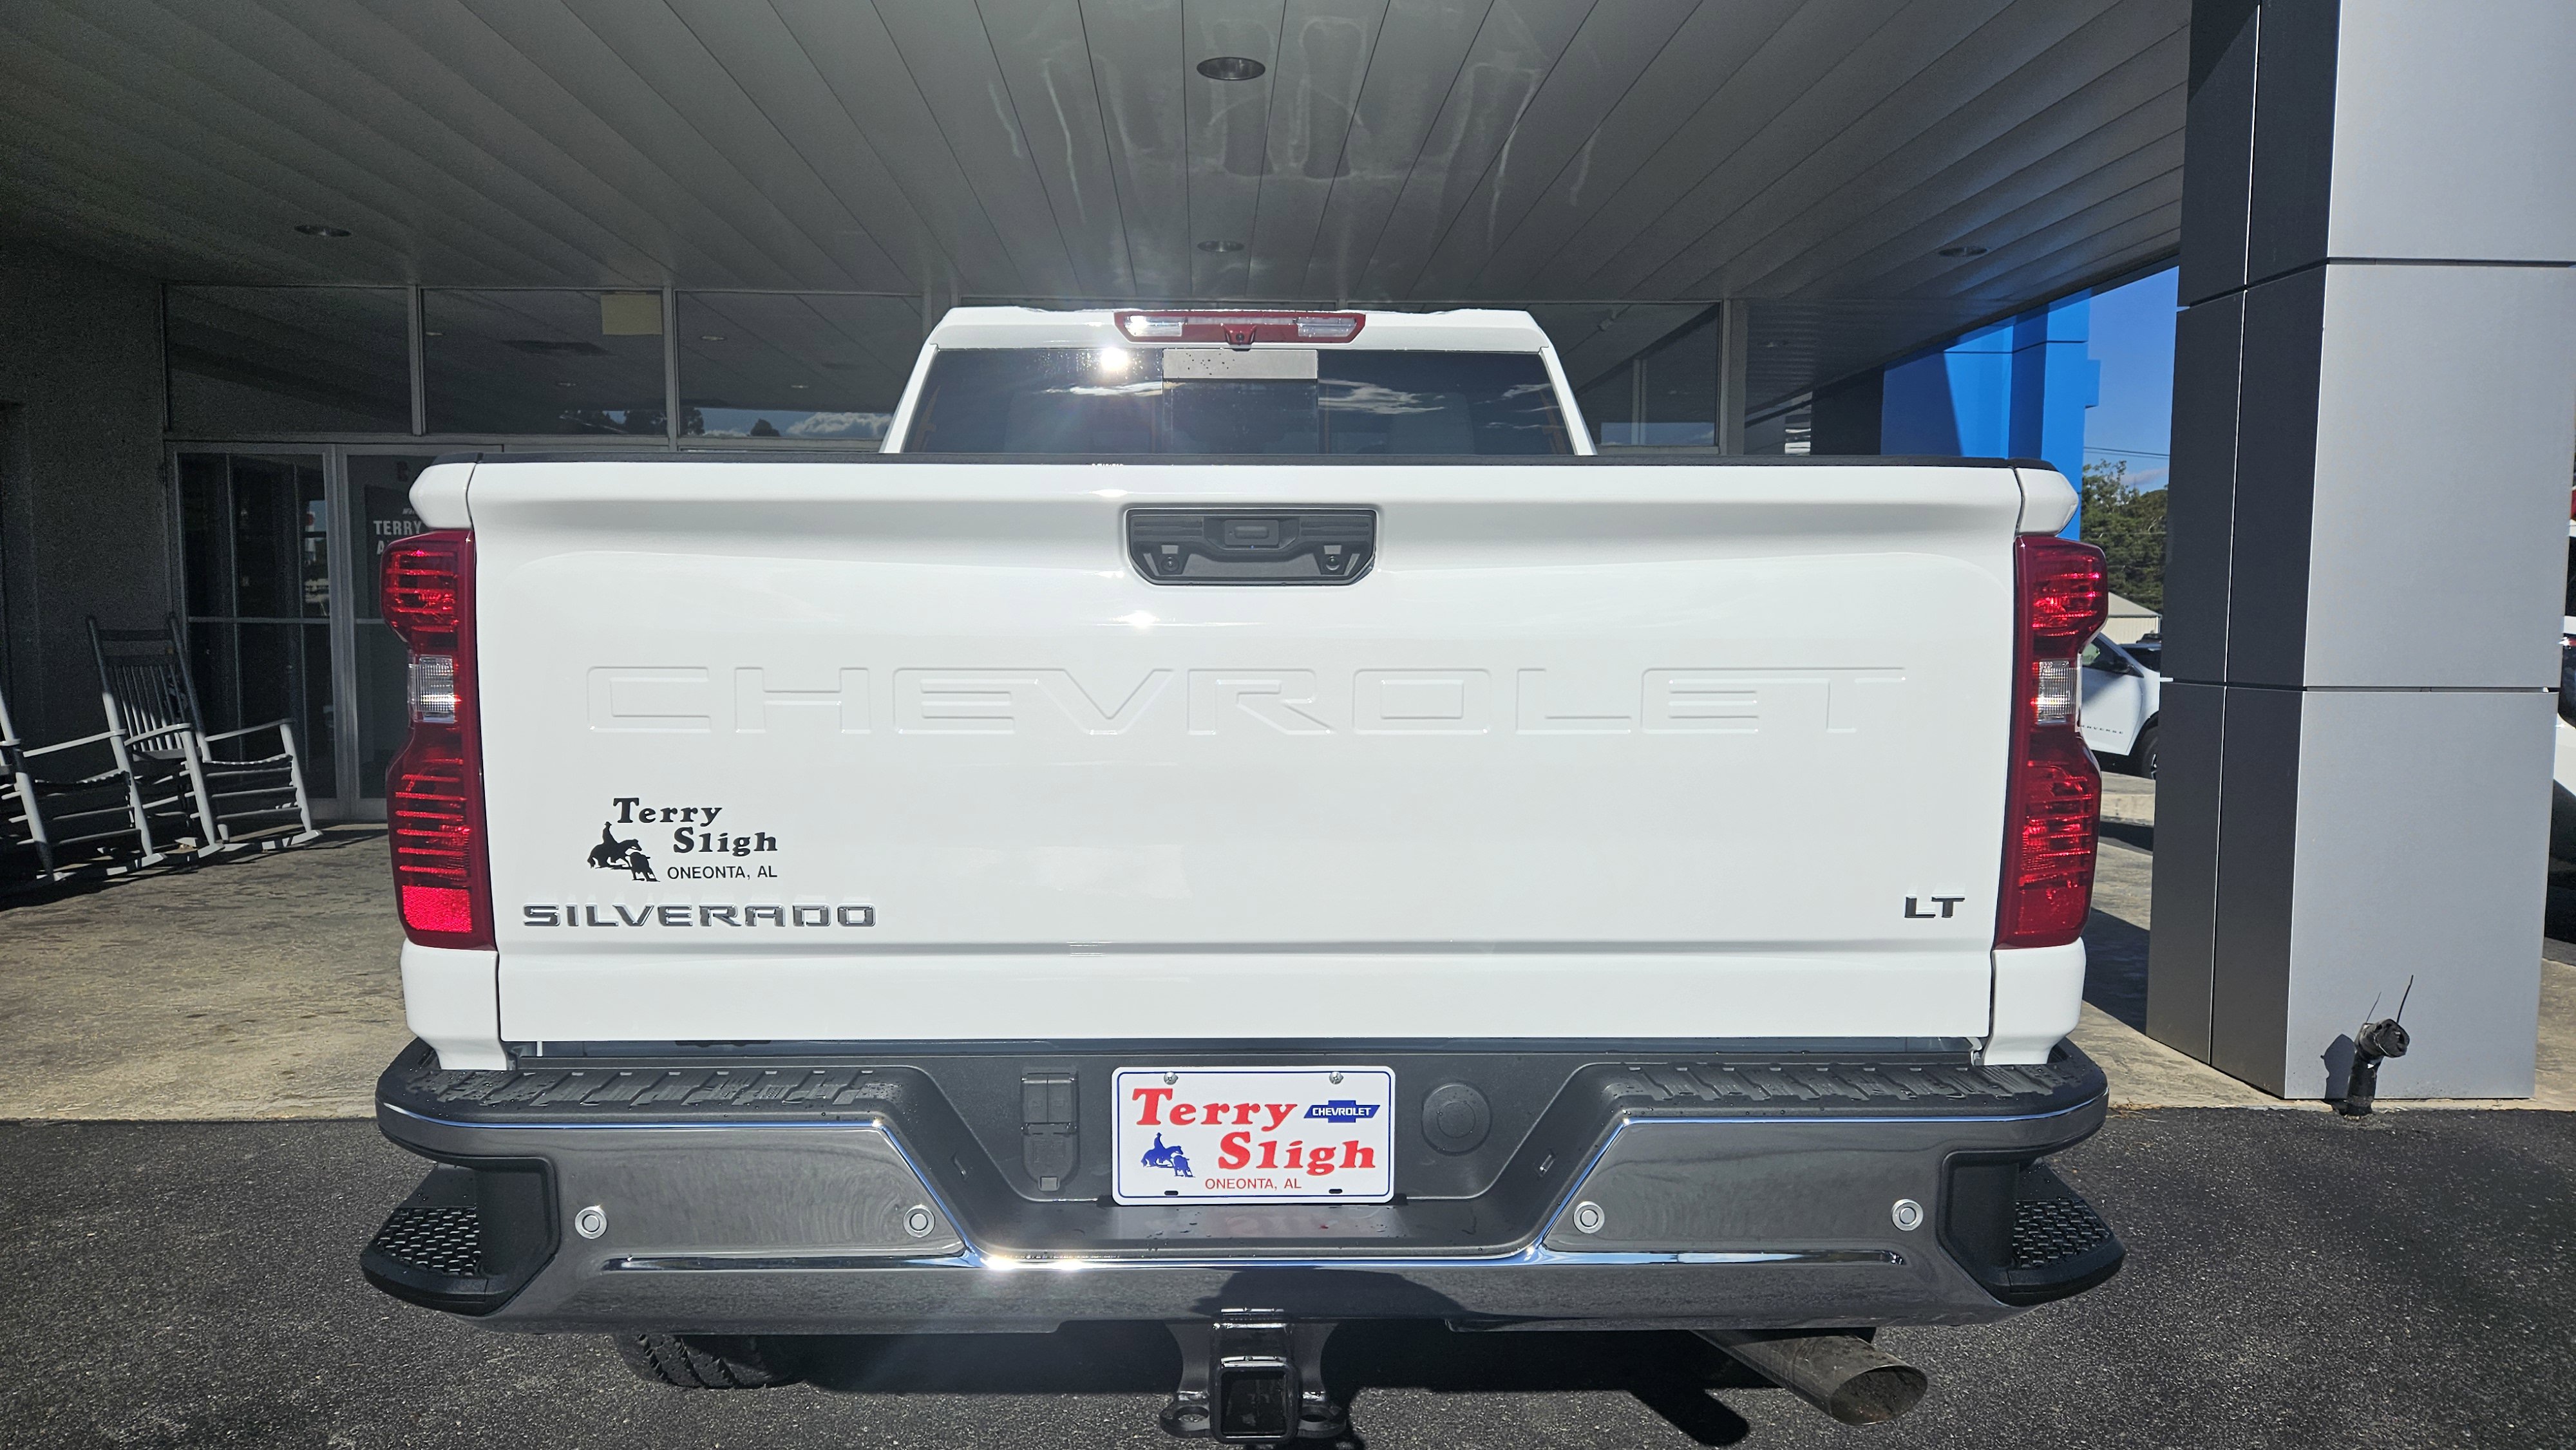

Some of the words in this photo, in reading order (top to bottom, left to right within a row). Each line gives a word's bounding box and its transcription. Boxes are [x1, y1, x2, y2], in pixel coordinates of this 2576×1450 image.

[373, 520, 422, 535] TERRY
[587, 666, 1906, 734] CHEVROLET
[2081, 724, 2124, 735] AVERSE
[612, 797, 723, 827] Terry
[673, 827, 778, 857] Sligh
[667, 865, 750, 880] ONEONTA,
[757, 865, 778, 878] AL
[523, 904, 876, 927] SILVERADO
[1904, 894, 1965, 918] LT
[1132, 1088, 1298, 1132] Terry
[1312, 1107, 1372, 1116] CHEVROLET
[1218, 1131, 1376, 1176] Sligh
[1205, 1178, 1277, 1191] ONEONTA,
[1283, 1178, 1302, 1189] AL
